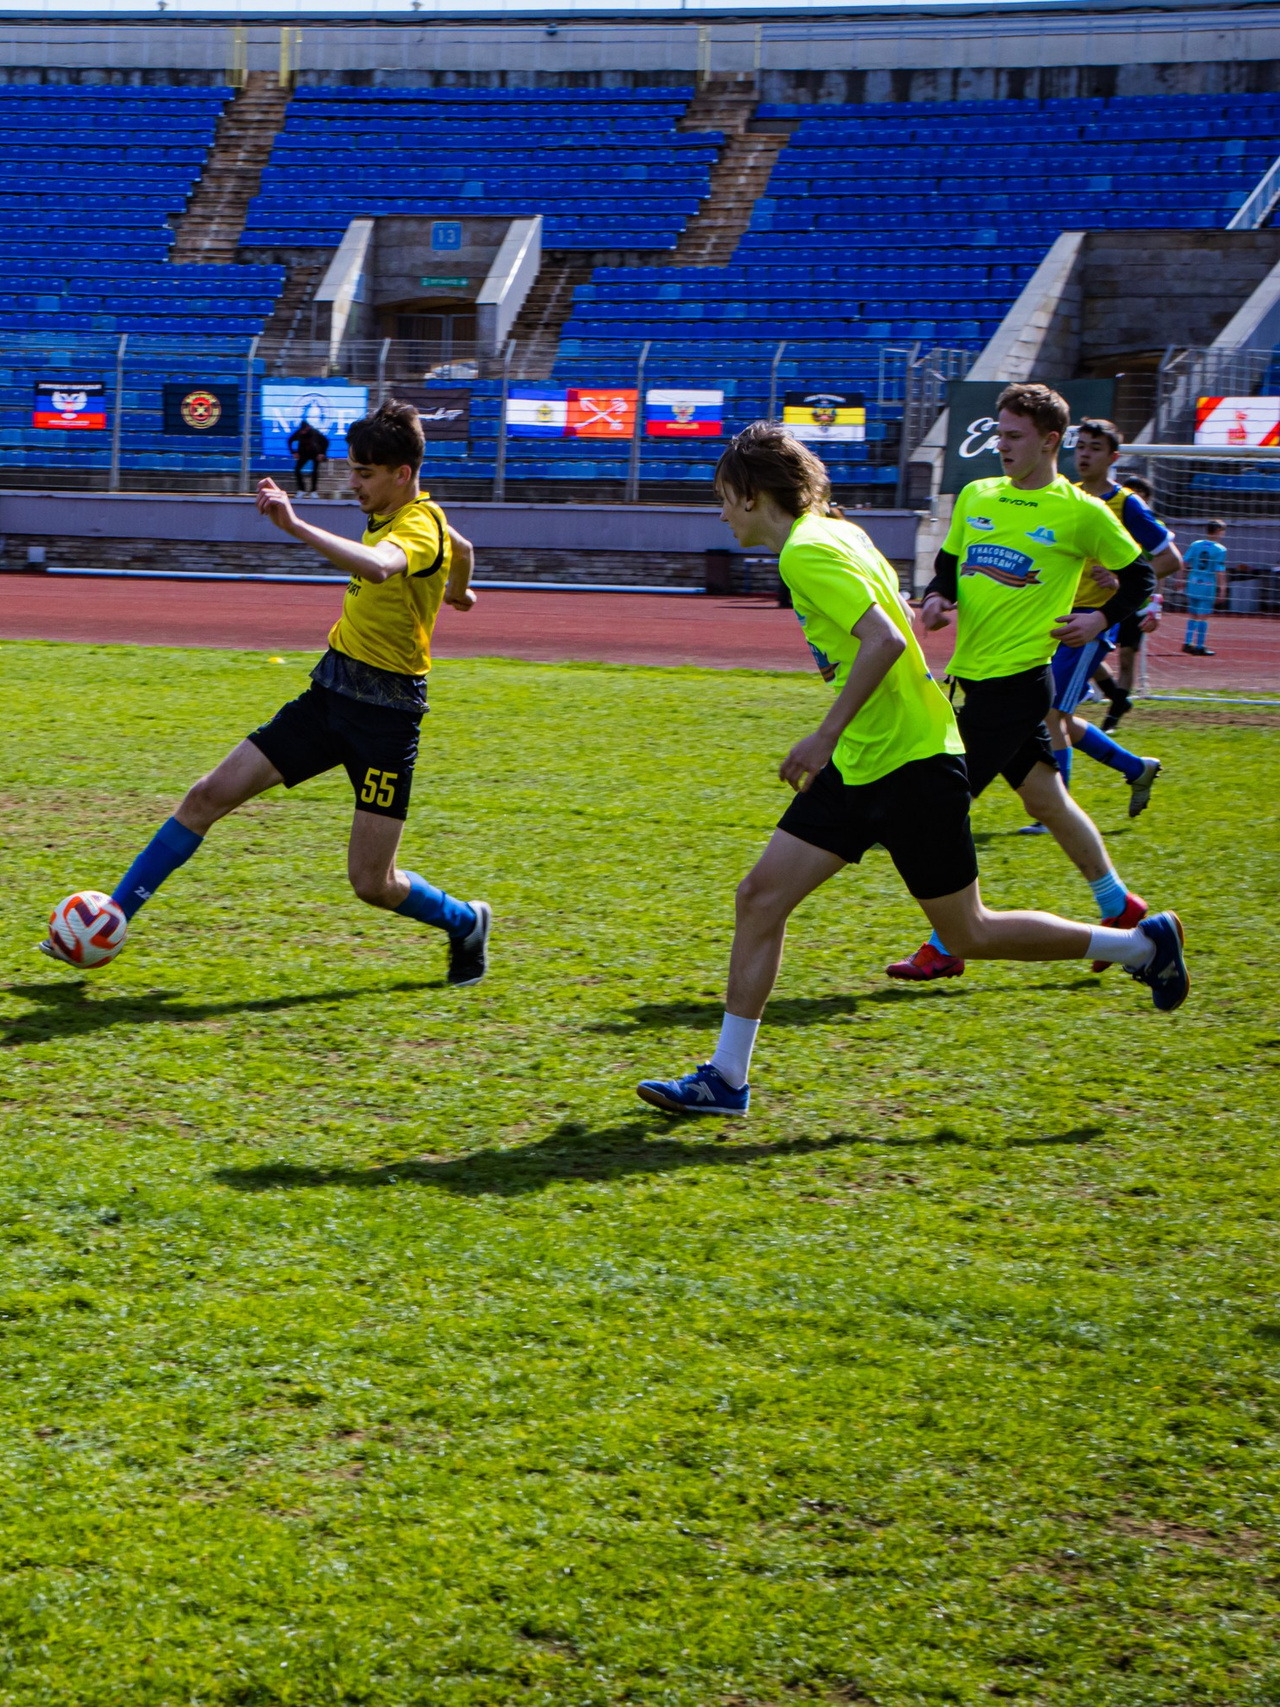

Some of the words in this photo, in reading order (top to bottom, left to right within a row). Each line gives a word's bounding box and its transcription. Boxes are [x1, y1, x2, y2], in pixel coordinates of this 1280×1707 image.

[437, 229, 456, 243] 13
[998, 496, 1039, 508] GIVOVA
[976, 555, 1017, 571] ПОБЕДЫ!
[360, 767, 399, 808] 55
